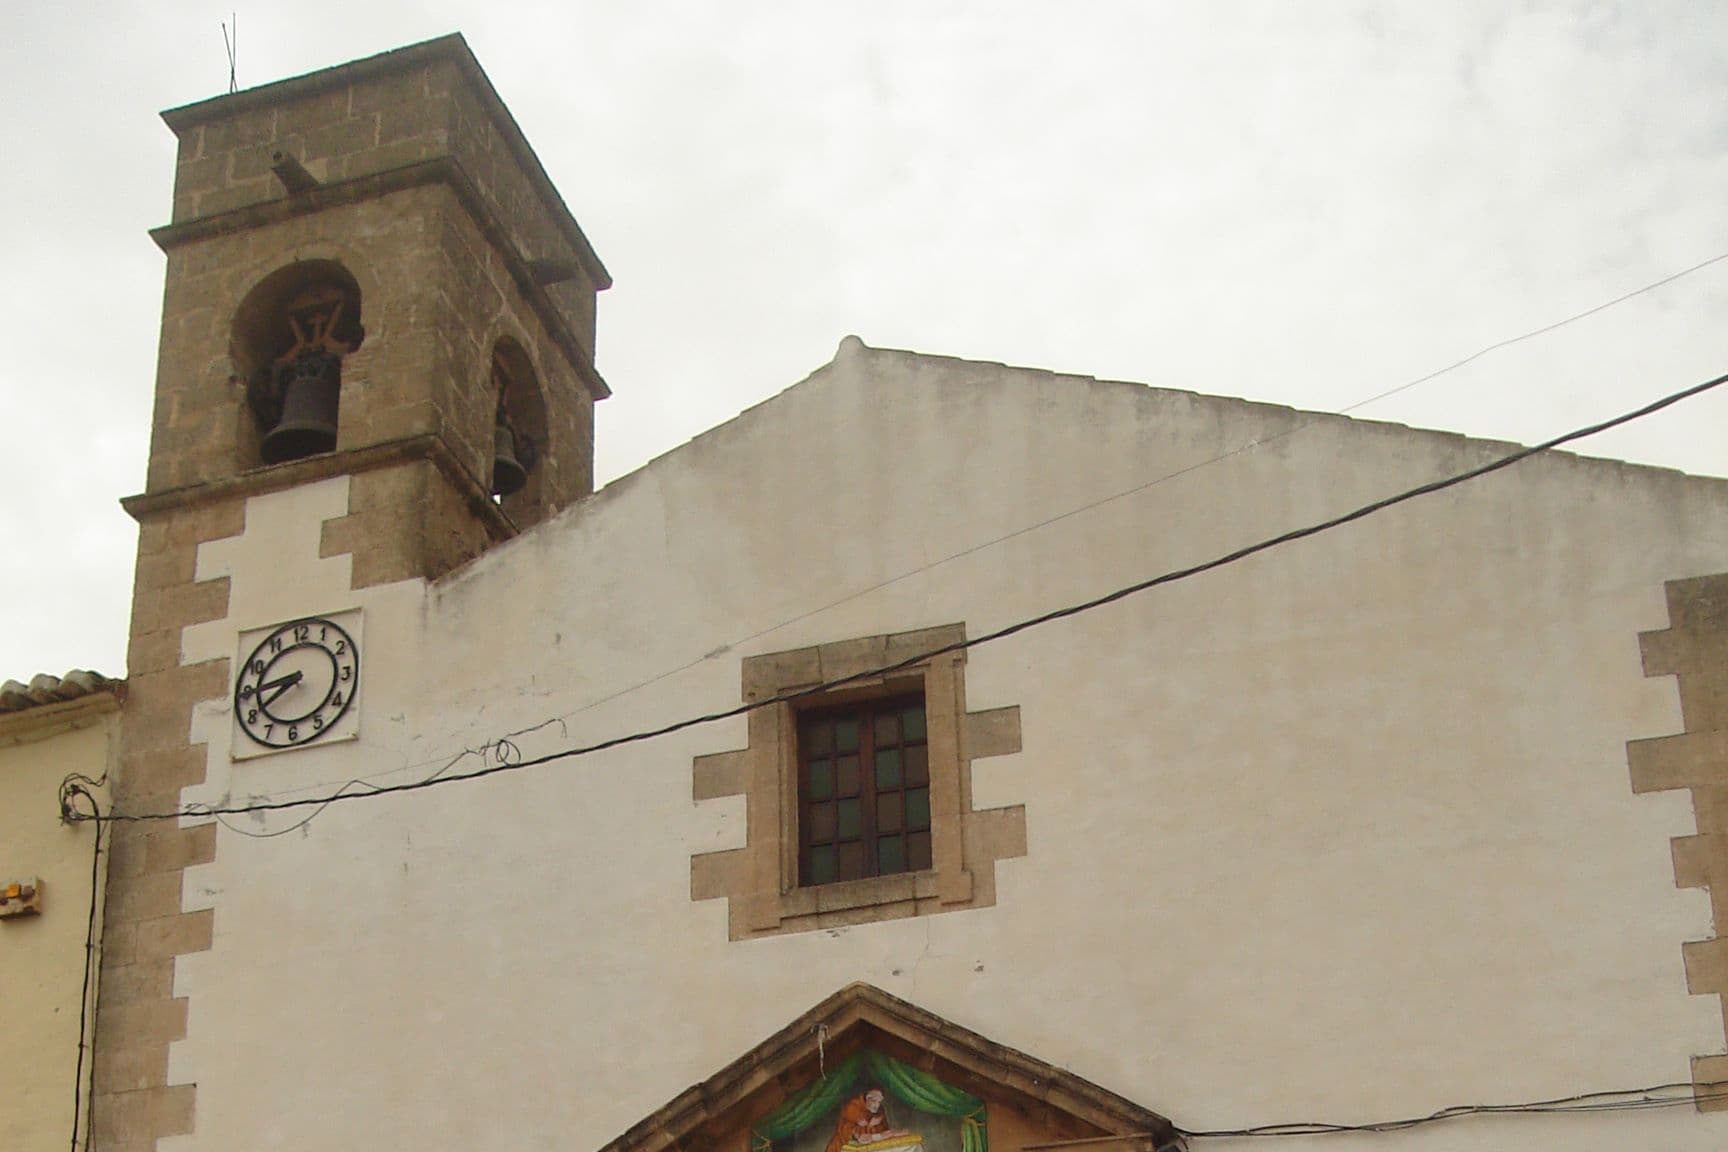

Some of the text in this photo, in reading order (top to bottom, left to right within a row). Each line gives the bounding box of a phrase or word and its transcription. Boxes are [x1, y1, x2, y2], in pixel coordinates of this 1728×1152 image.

[293, 625, 309, 642] 12
[319, 626, 326, 642] 1
[269, 637, 282, 654] 11
[335, 640, 345, 656] 2
[249, 659, 264, 676] 10
[341, 666, 351, 681] 3
[331, 691, 342, 706] 4
[247, 709, 257, 725] 8
[313, 714, 323, 730] 5
[263, 724, 273, 740] 7
[288, 725, 298, 741] 6
